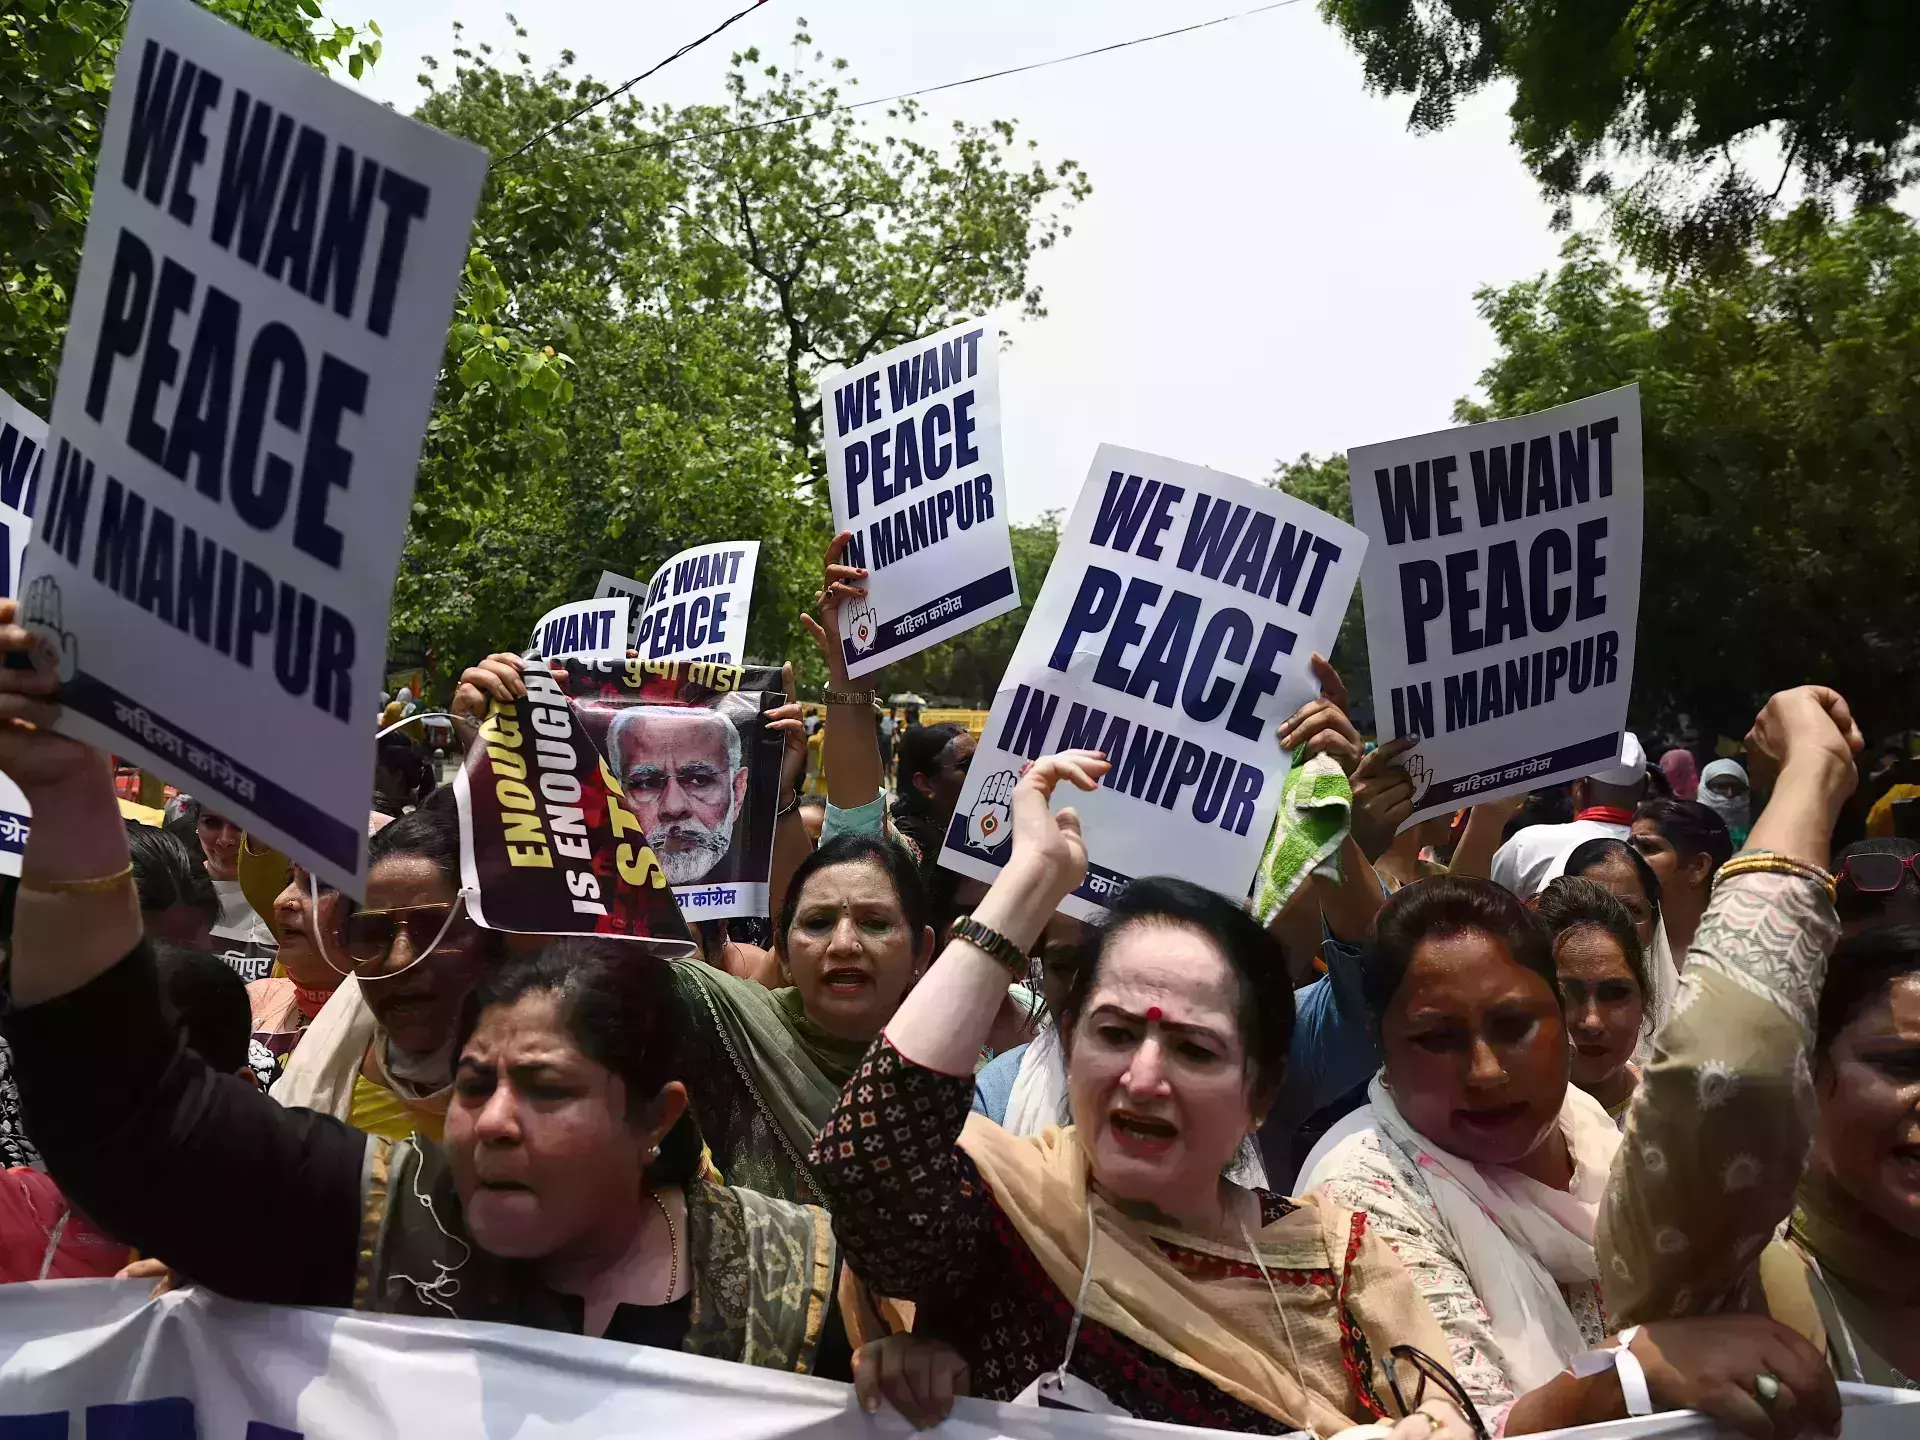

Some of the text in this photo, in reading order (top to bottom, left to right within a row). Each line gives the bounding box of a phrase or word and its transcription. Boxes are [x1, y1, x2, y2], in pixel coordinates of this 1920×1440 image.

[122, 38, 430, 338] WE WANT
[85, 226, 370, 569] PEACE
[833, 328, 984, 437] WE WANT
[844, 390, 979, 519] PEACE
[1374, 416, 1619, 546] WE WANT
[869, 473, 995, 571] MANIPUR
[1089, 471, 1342, 617] WE WANT
[41, 436, 95, 569] IN
[92, 475, 358, 724] MANIPUR
[541, 610, 616, 658] WANT
[635, 593, 731, 659] PEACE
[645, 551, 746, 612] WE WANT
[894, 595, 963, 636] महिला कांग्रेस
[1398, 517, 1608, 665] PEACE
[1047, 564, 1298, 742] PEACE
[1391, 630, 1619, 740] IN MANIPUR
[113, 701, 257, 802] महिला कांग्रेस
[996, 684, 1265, 837] IN MANIPUR
[1452, 757, 1553, 793] महिला कांग्रेस
[565, 869, 608, 916] IS
[691, 887, 737, 907] कांग्रेस
